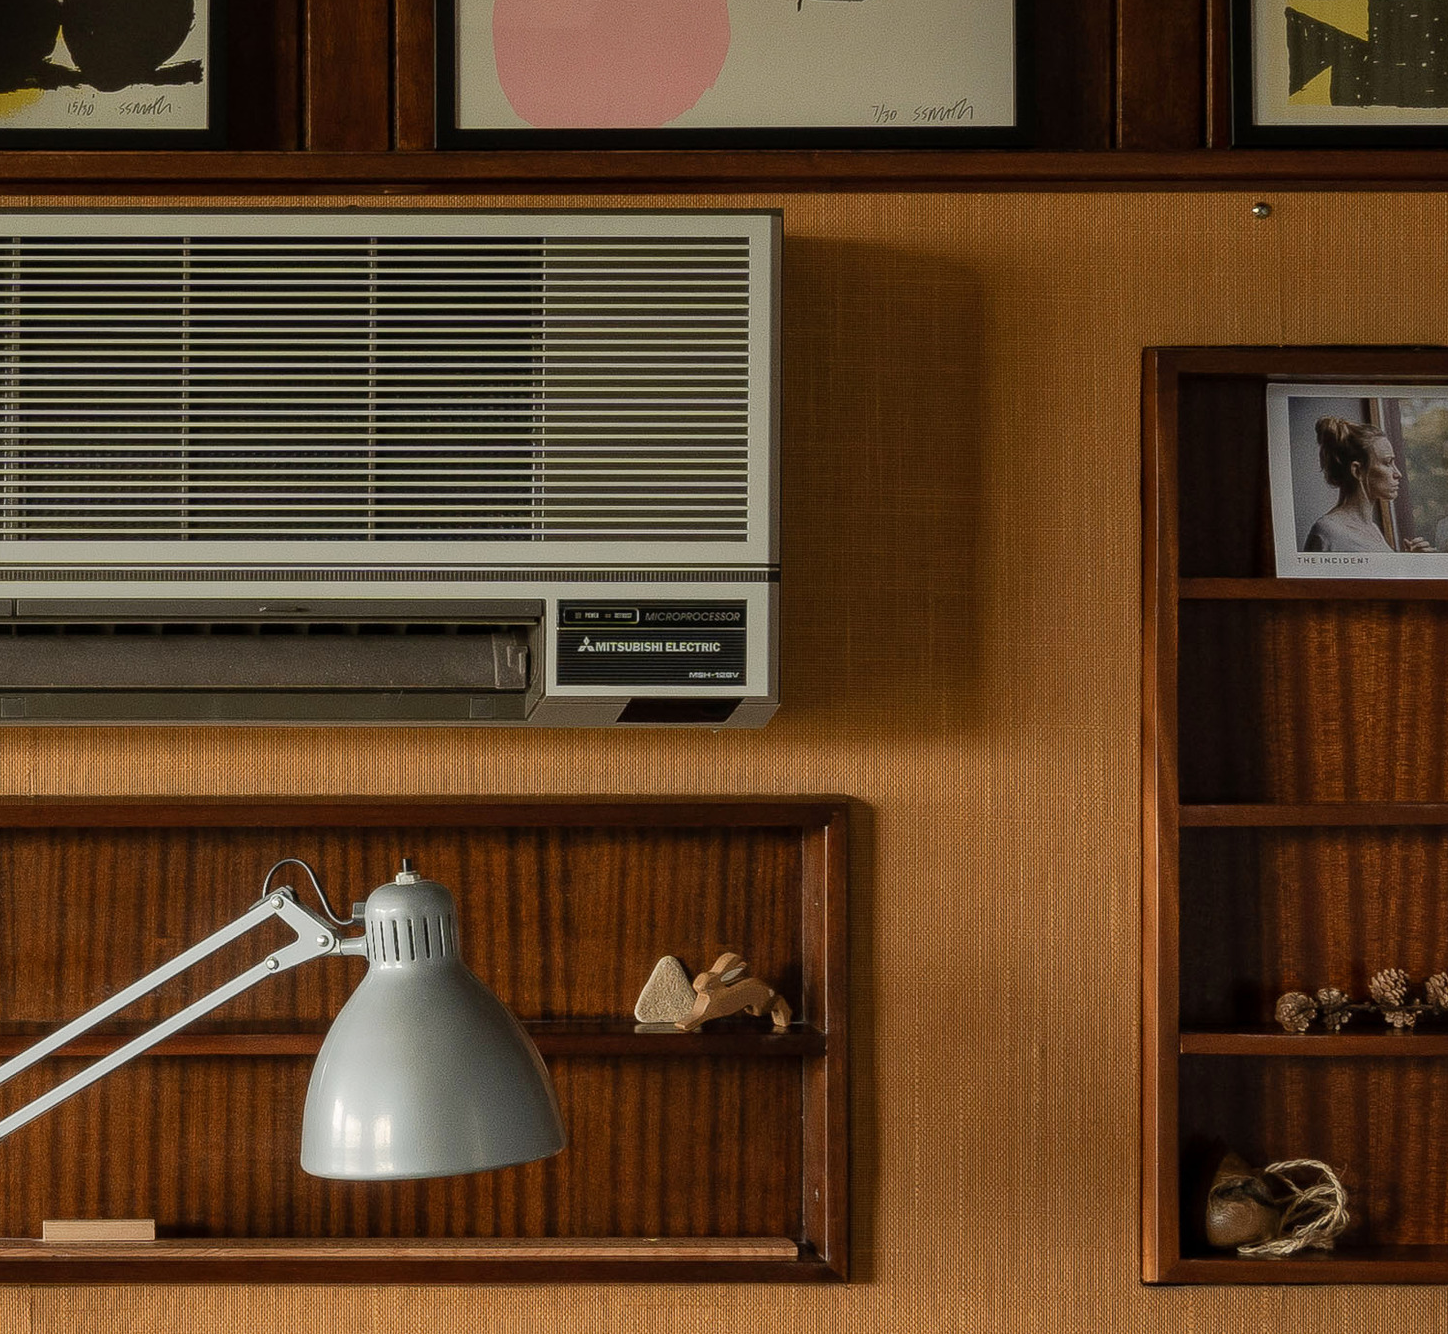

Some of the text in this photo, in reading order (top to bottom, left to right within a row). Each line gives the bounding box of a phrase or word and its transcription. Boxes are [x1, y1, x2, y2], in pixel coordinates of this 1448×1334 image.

[872, 104, 898, 123] 7/30
[644, 612, 741, 622] MICROPROCESSOR
[595, 641, 721, 652] MITSUBISHI ELECTRIC
